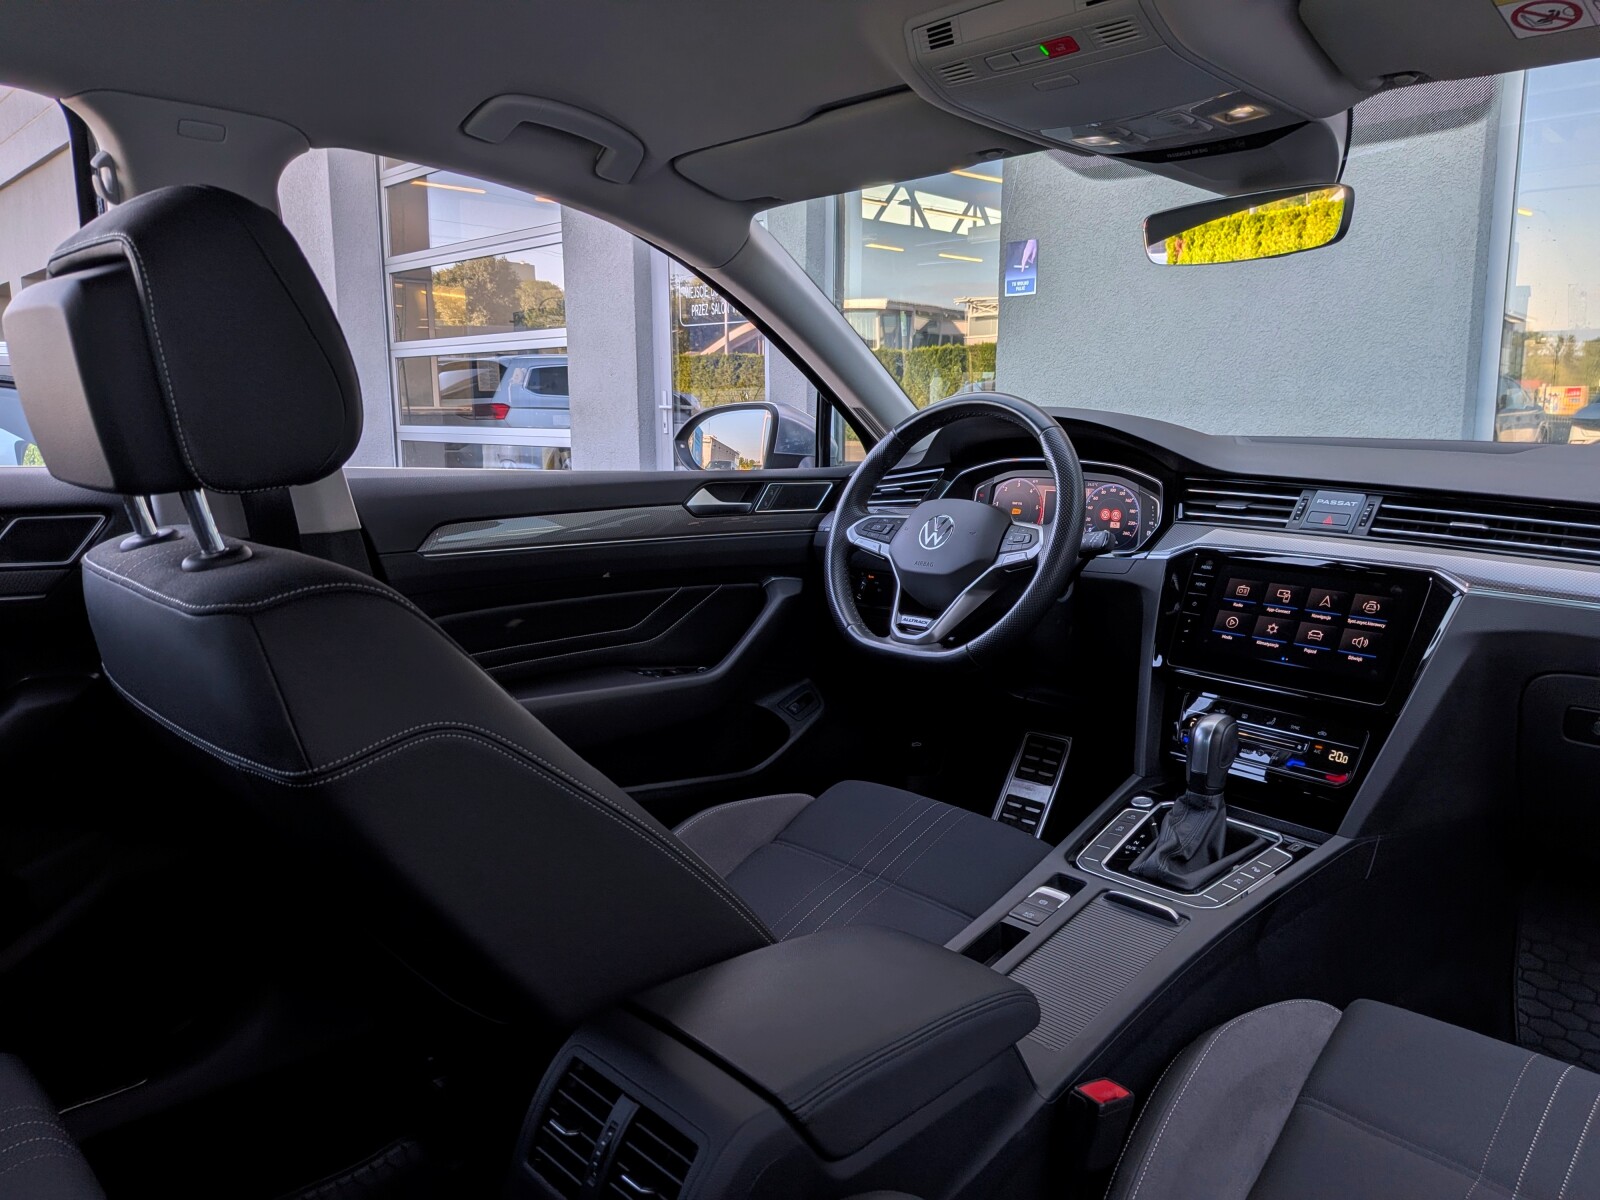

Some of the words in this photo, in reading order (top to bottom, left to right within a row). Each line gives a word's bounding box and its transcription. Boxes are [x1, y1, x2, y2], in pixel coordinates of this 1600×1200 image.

[691, 304, 709, 317] PRZEZ
[711, 302, 730, 316] SALON
[1316, 499, 1358, 507] PASSAT
[914, 560, 934, 568] AIRBAG
[902, 616, 928, 625] ALLTRACK
[1303, 647, 1318, 655] Pojazd
